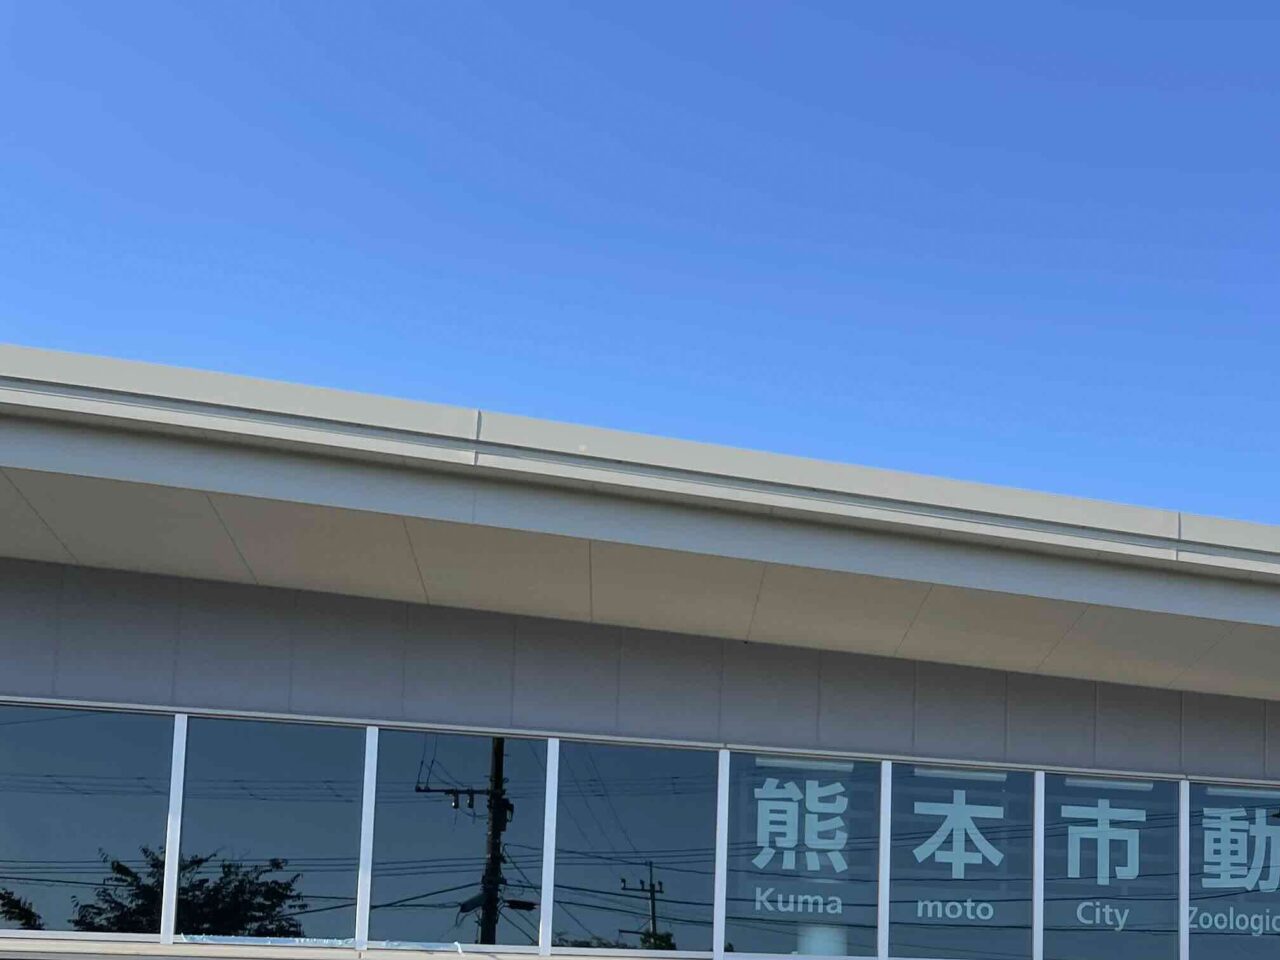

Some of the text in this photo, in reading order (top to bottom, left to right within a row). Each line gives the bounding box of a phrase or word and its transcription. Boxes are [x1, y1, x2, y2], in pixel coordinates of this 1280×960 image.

[755, 887, 842, 915] Kuma
[917, 898, 994, 921] moto
[1076, 901, 1129, 931] City
